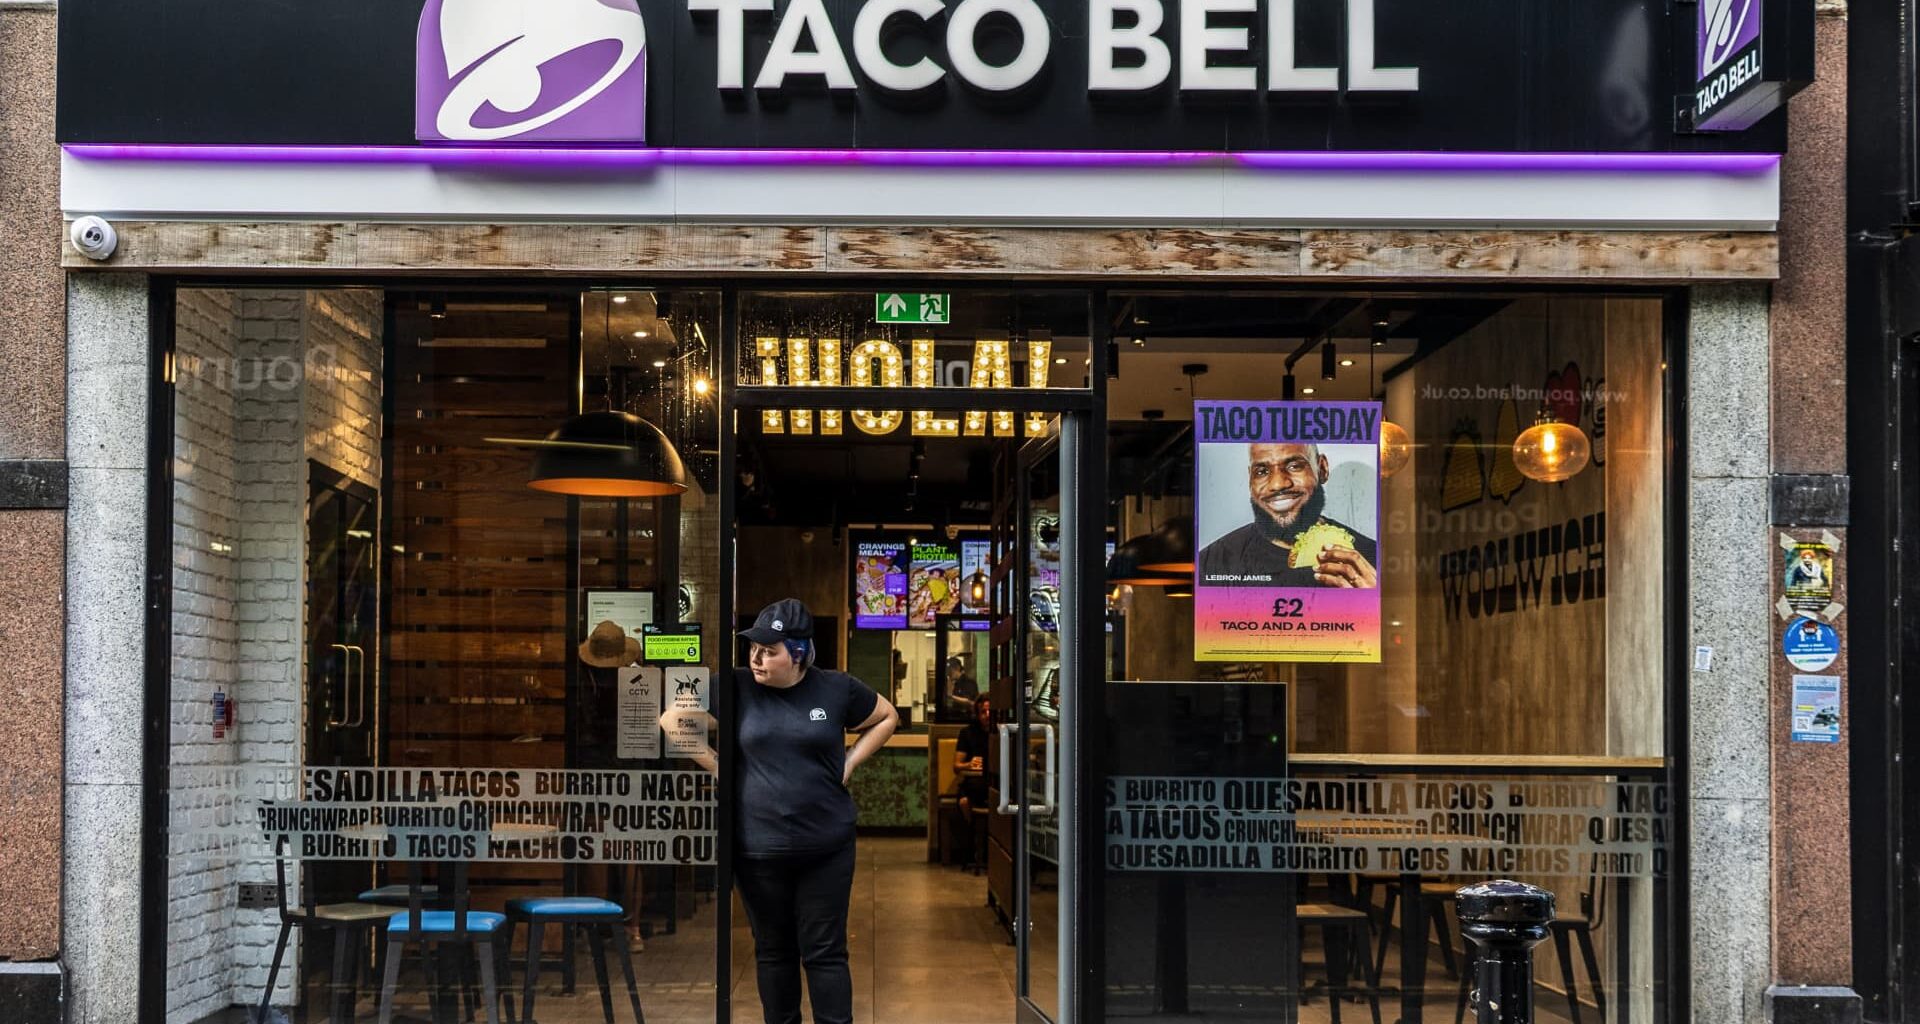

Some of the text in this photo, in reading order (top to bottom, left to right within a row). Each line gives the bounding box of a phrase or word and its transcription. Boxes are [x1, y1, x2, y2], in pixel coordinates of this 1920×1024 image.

[688, 0, 1420, 92] TACO BELL
[1696, 49, 1760, 115] TACO BELL
[1199, 407, 1377, 441] TACO TUESDAY
[912, 546, 948, 554] PLANT
[1243, 574, 1272, 582] JAMES
[1440, 511, 1605, 624] WOOLWICH
[1272, 598, 1303, 617] £2
[1220, 621, 1355, 632] TACO AND A DRINK
[629, 688, 649, 696] CCTV
[440, 771, 520, 798] TACOS
[535, 772, 630, 796] BURRITO
[1126, 779, 1217, 802] BURRITO
[1223, 780, 1409, 816] QUESADILLA
[1415, 782, 1493, 810] TACOS
[1509, 784, 1606, 808] BURRITO
[257, 807, 368, 832] CRUNCHWRAP
[370, 806, 455, 828] BURRITO
[459, 800, 611, 833] CRUNCHWRAP
[1126, 805, 1220, 840] TACOS
[1431, 812, 1586, 845] CRUNCHWRAP
[302, 834, 397, 858] BURRITO
[406, 834, 476, 858] TACOS
[487, 834, 594, 860] NACHOS
[602, 839, 666, 861] BURRITO
[1108, 844, 1261, 869] QUESADILLA
[1272, 846, 1368, 871] BURRITO
[1377, 847, 1449, 871] TACOS
[1461, 847, 1570, 872] NACHOS
[1578, 851, 1643, 874] BURRITO
